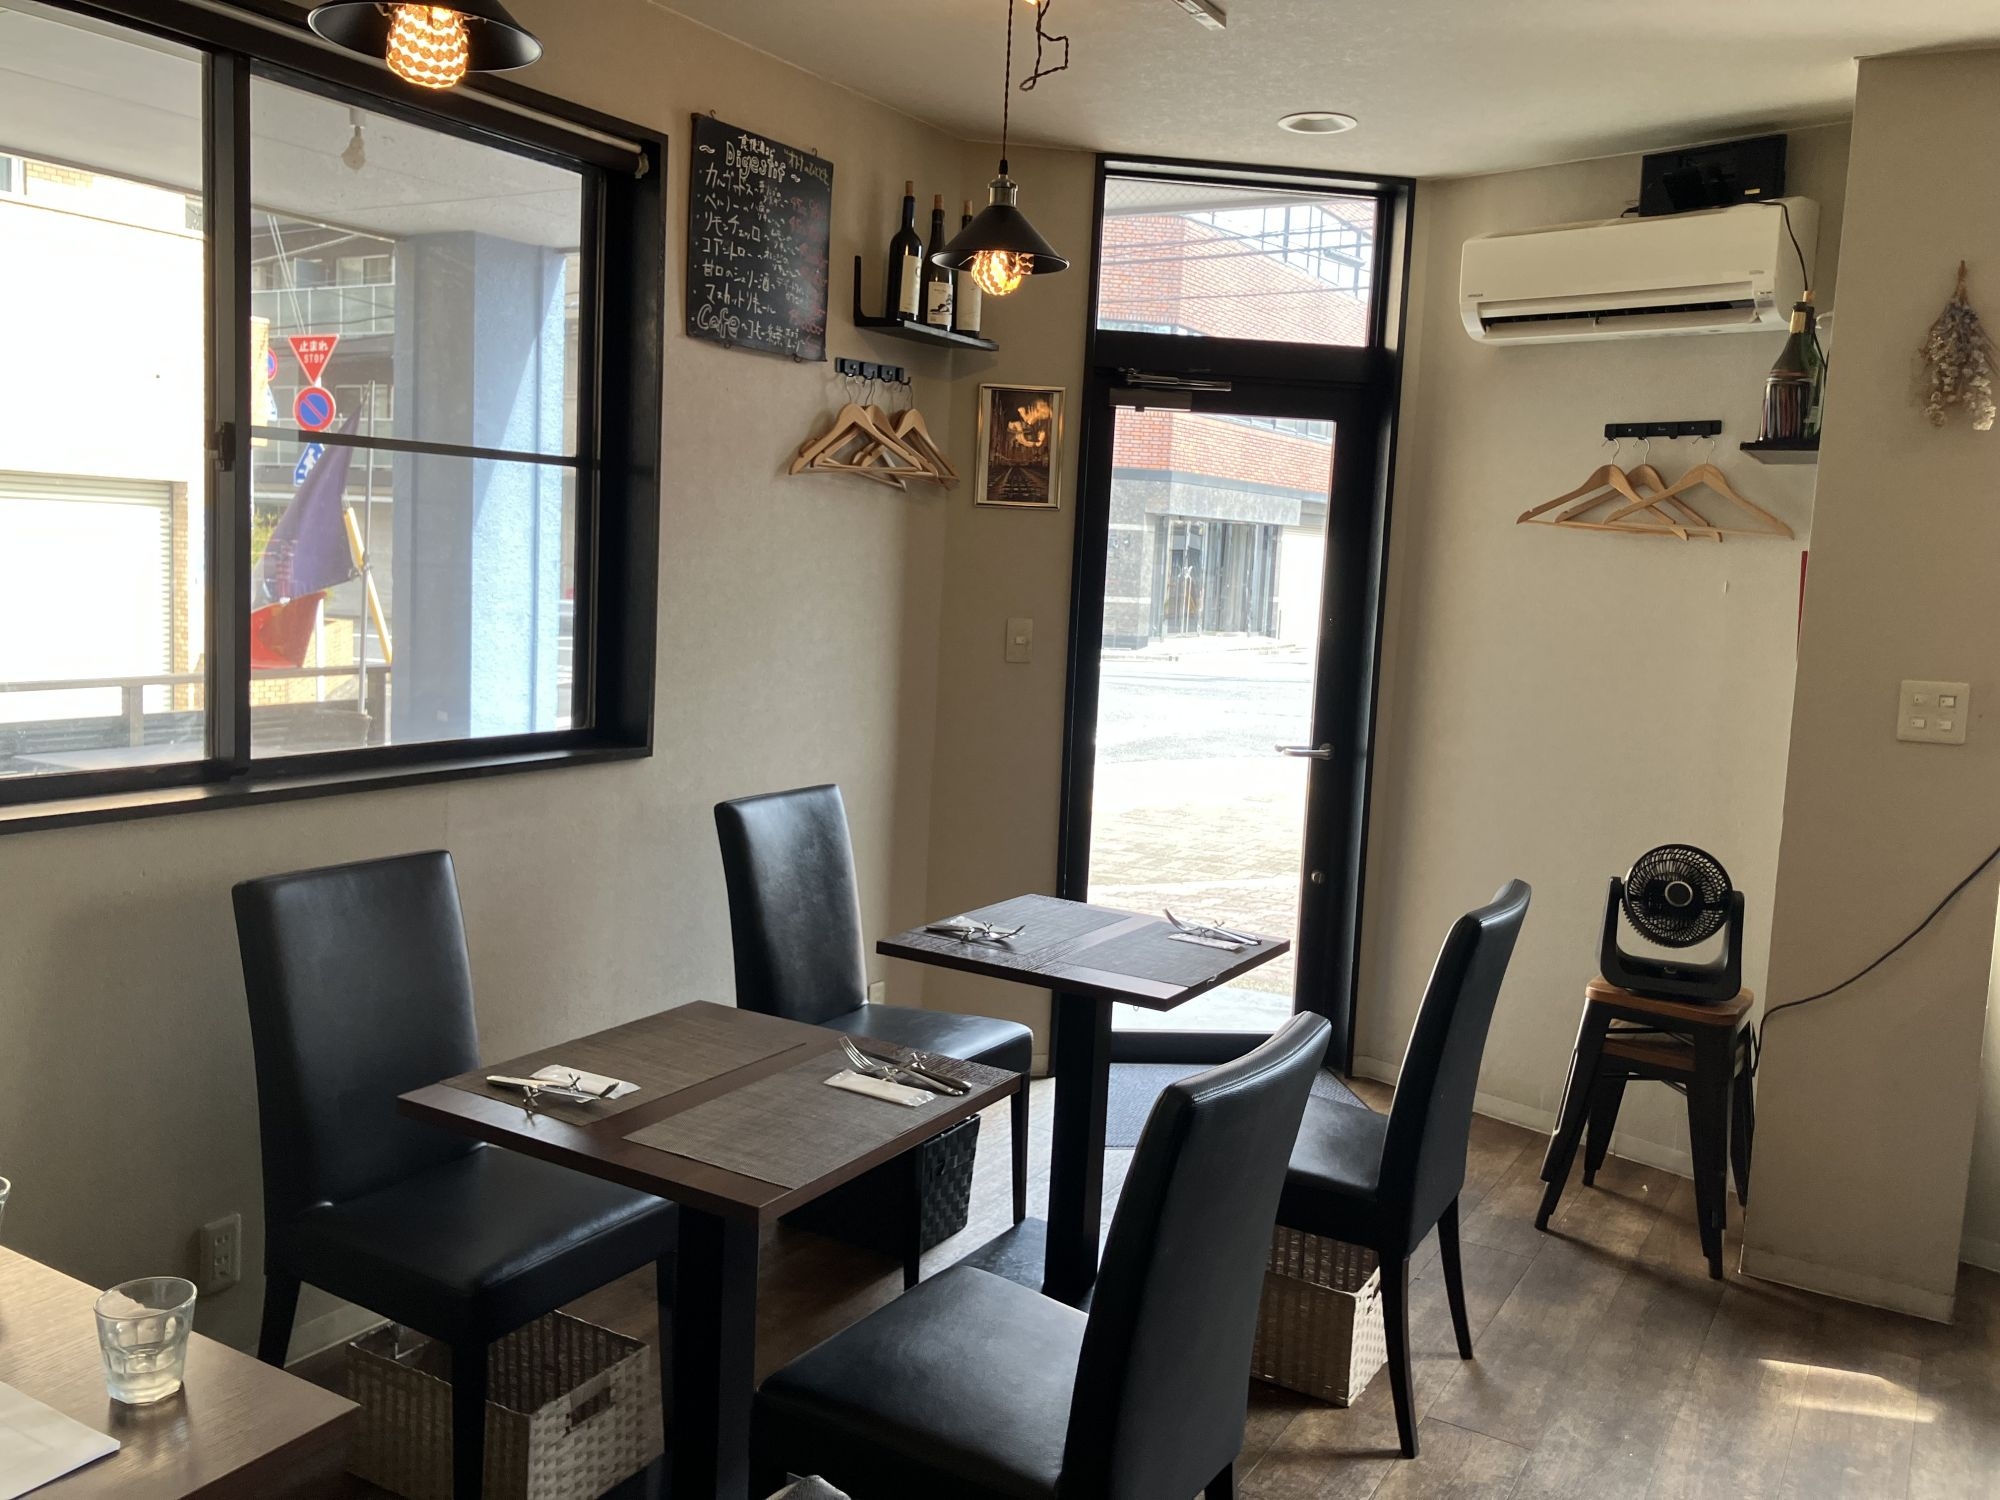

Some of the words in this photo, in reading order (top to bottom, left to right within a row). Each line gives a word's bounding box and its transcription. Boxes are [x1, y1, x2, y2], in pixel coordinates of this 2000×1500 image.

[298, 340, 329, 353] 止まれ
[303, 355, 325, 364] STOP
